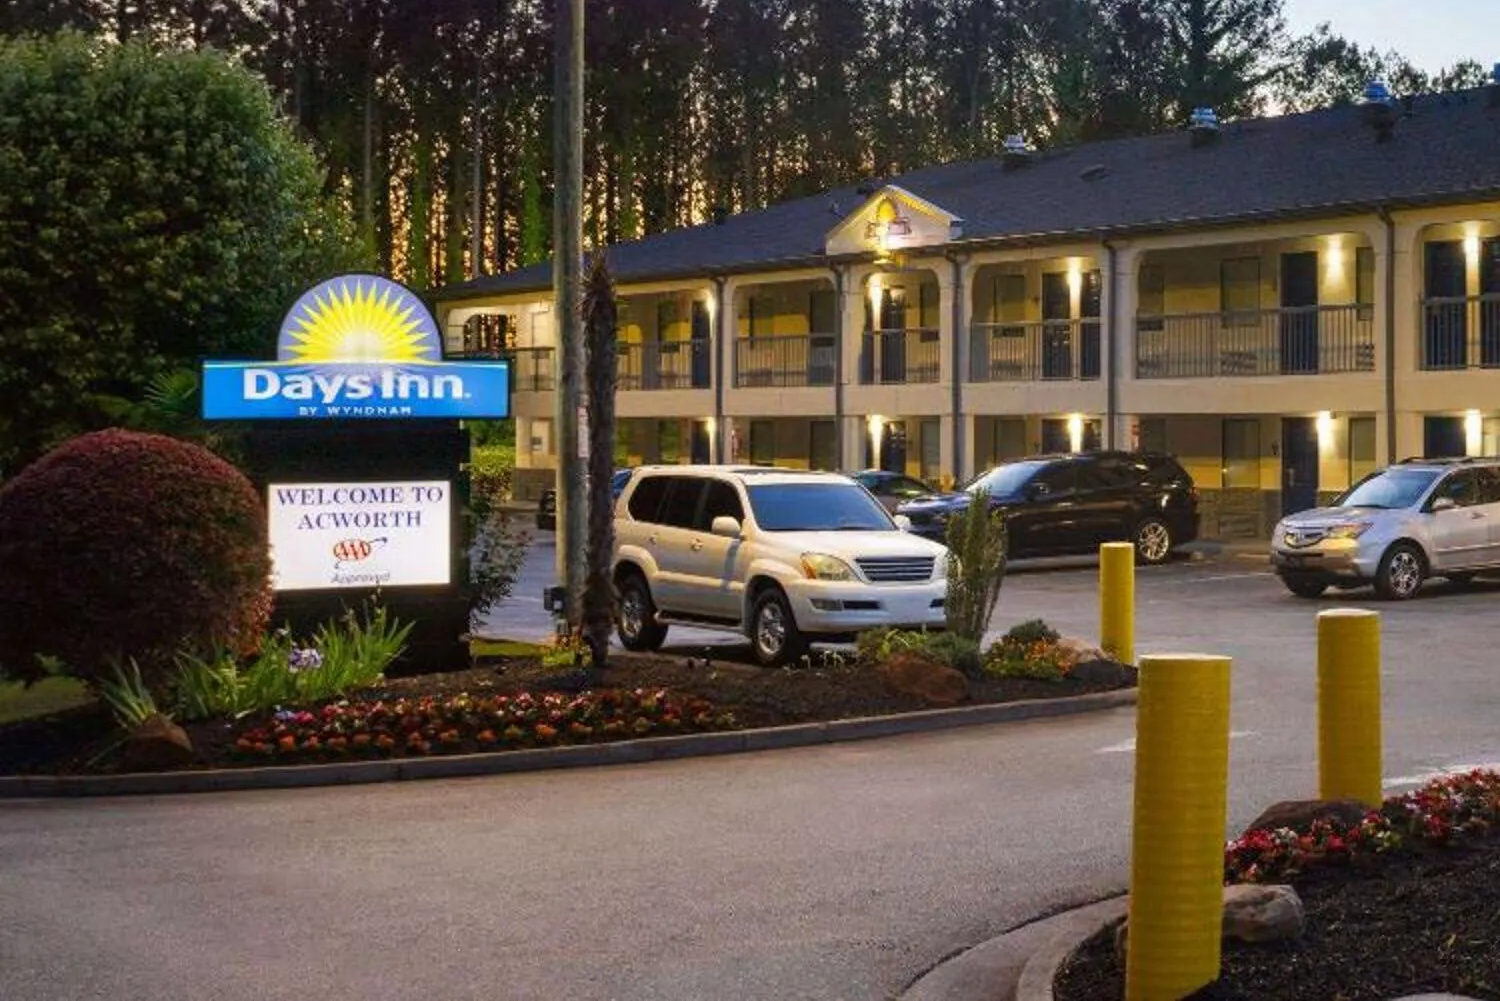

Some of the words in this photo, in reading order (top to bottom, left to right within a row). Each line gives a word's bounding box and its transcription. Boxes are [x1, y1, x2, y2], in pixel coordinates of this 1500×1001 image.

[243, 368, 373, 404] Days
[299, 405, 317, 416] BY
[327, 405, 412, 416] WYNDHAM
[277, 487, 405, 506] WELCOME
[411, 486, 444, 504] TO
[297, 510, 422, 530] ACWORTH
[330, 572, 390, 585] Approved
